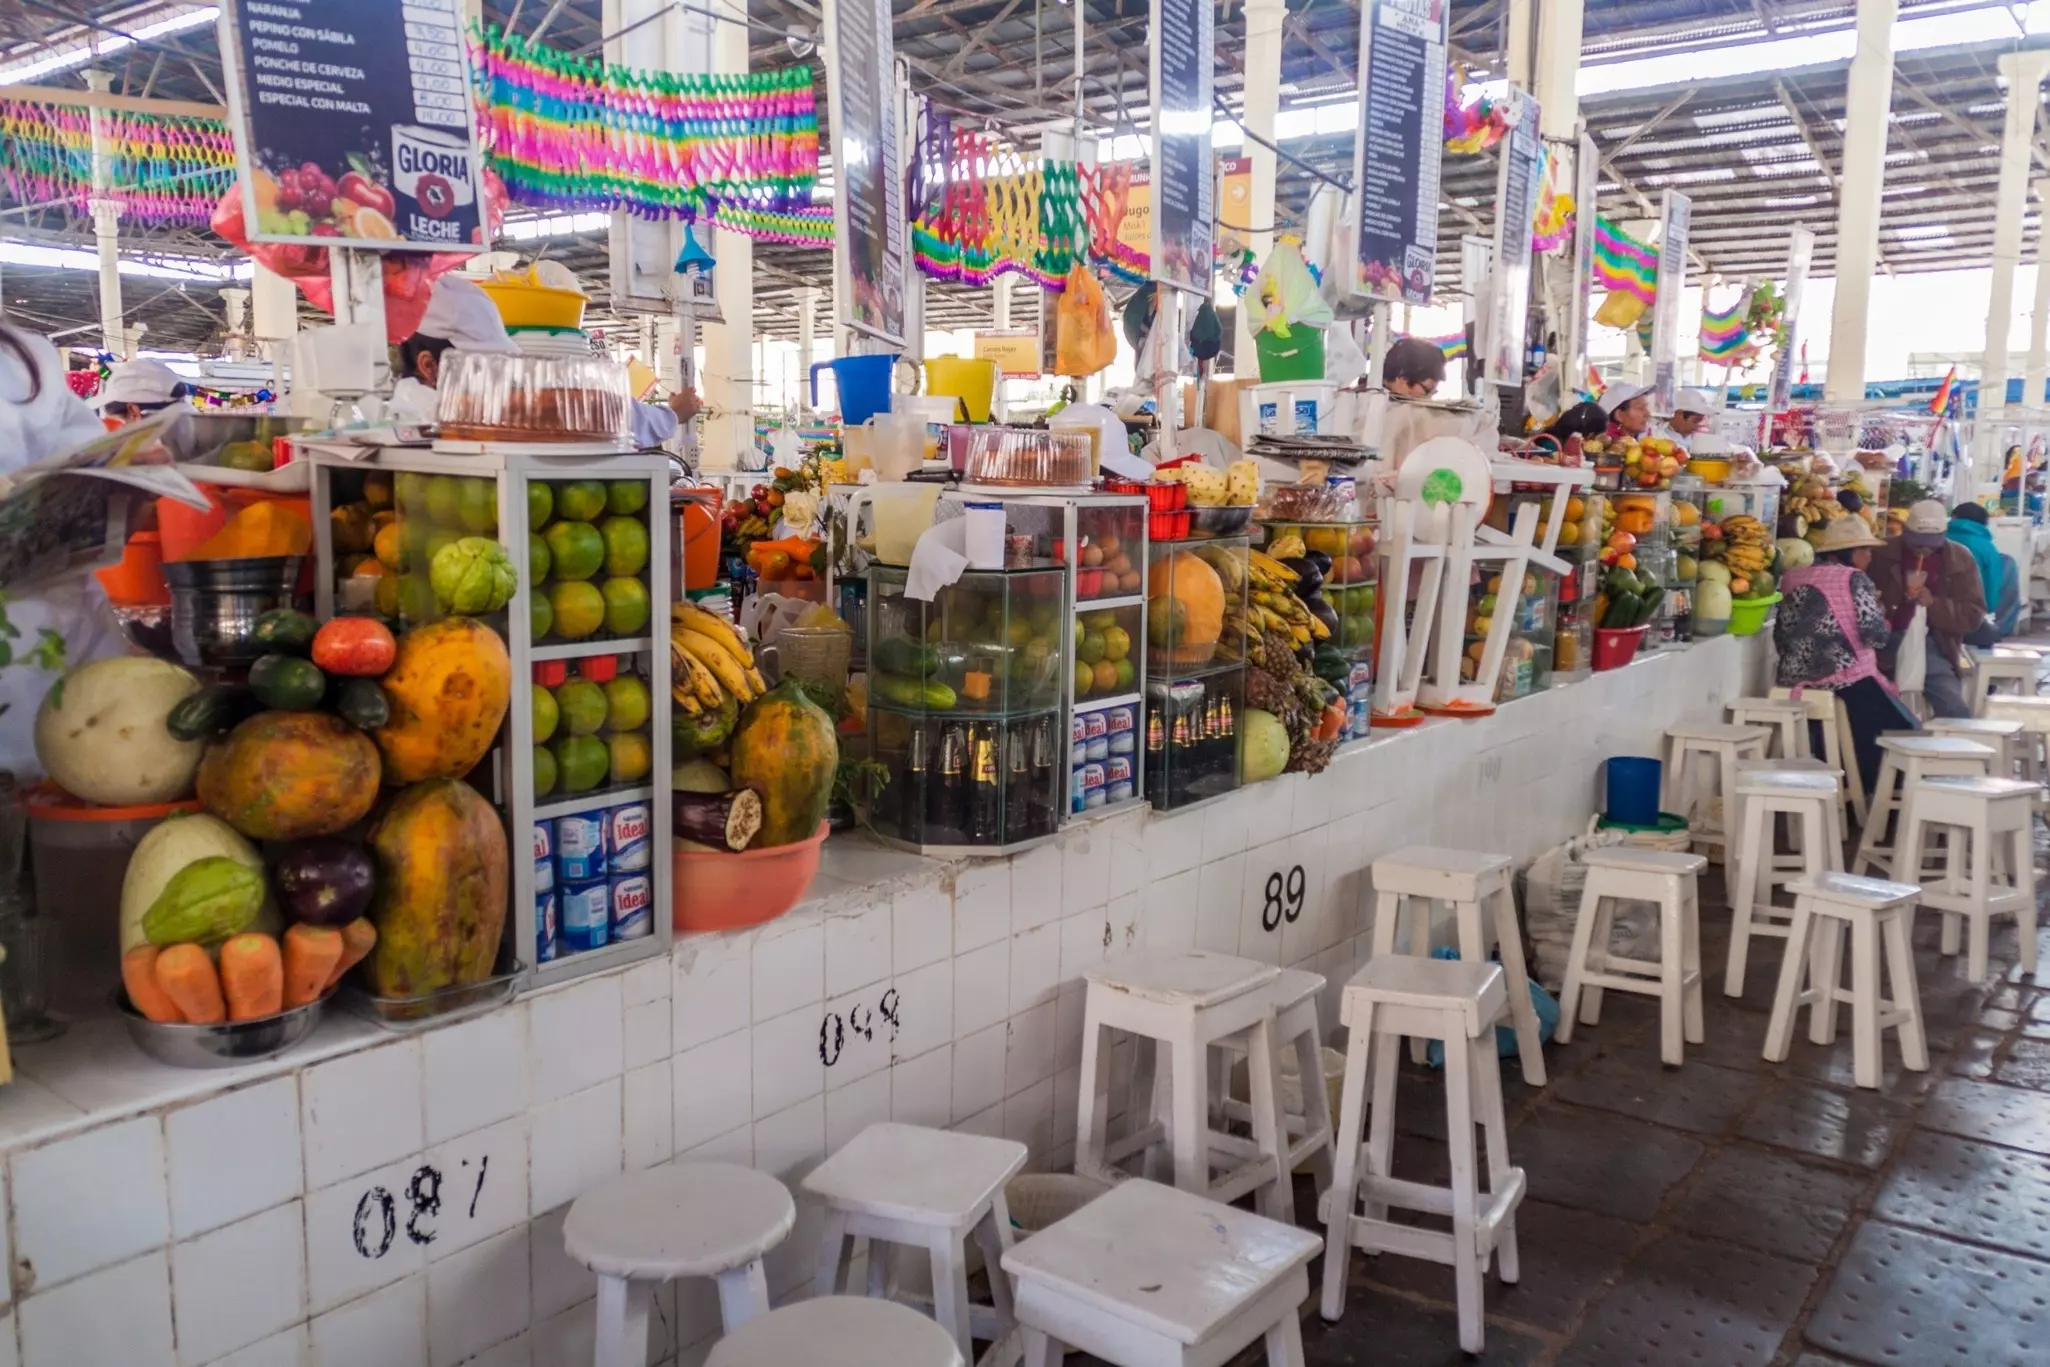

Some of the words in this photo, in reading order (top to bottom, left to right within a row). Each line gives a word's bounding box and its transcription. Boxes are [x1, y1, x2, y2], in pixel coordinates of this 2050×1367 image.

[247, 3, 301, 20] NARANJA
[249, 20, 290, 36] PEPINO
[292, 26, 315, 39] CON
[252, 37, 299, 54] POMELO
[254, 55, 300, 72] PONCHE
[302, 62, 317, 74] DE
[318, 63, 365, 79] CERVEZA
[256, 73, 293, 88] MEDIO
[294, 78, 345, 94] ESPECIAL
[259, 91, 309, 108] ESPECIAL
[311, 97, 334, 110] CON
[335, 100, 371, 114] MALTA
[398, 143, 469, 186] GLORIA
[409, 213, 461, 239] LECHE
[1073, 726, 1084, 739] eal
[1085, 773, 1104, 787] deal
[1107, 766, 1128, 780] deal
[616, 818, 648, 840] Ideal
[617, 887, 648, 910] Ideal
[1262, 864, 1306, 933] 89
